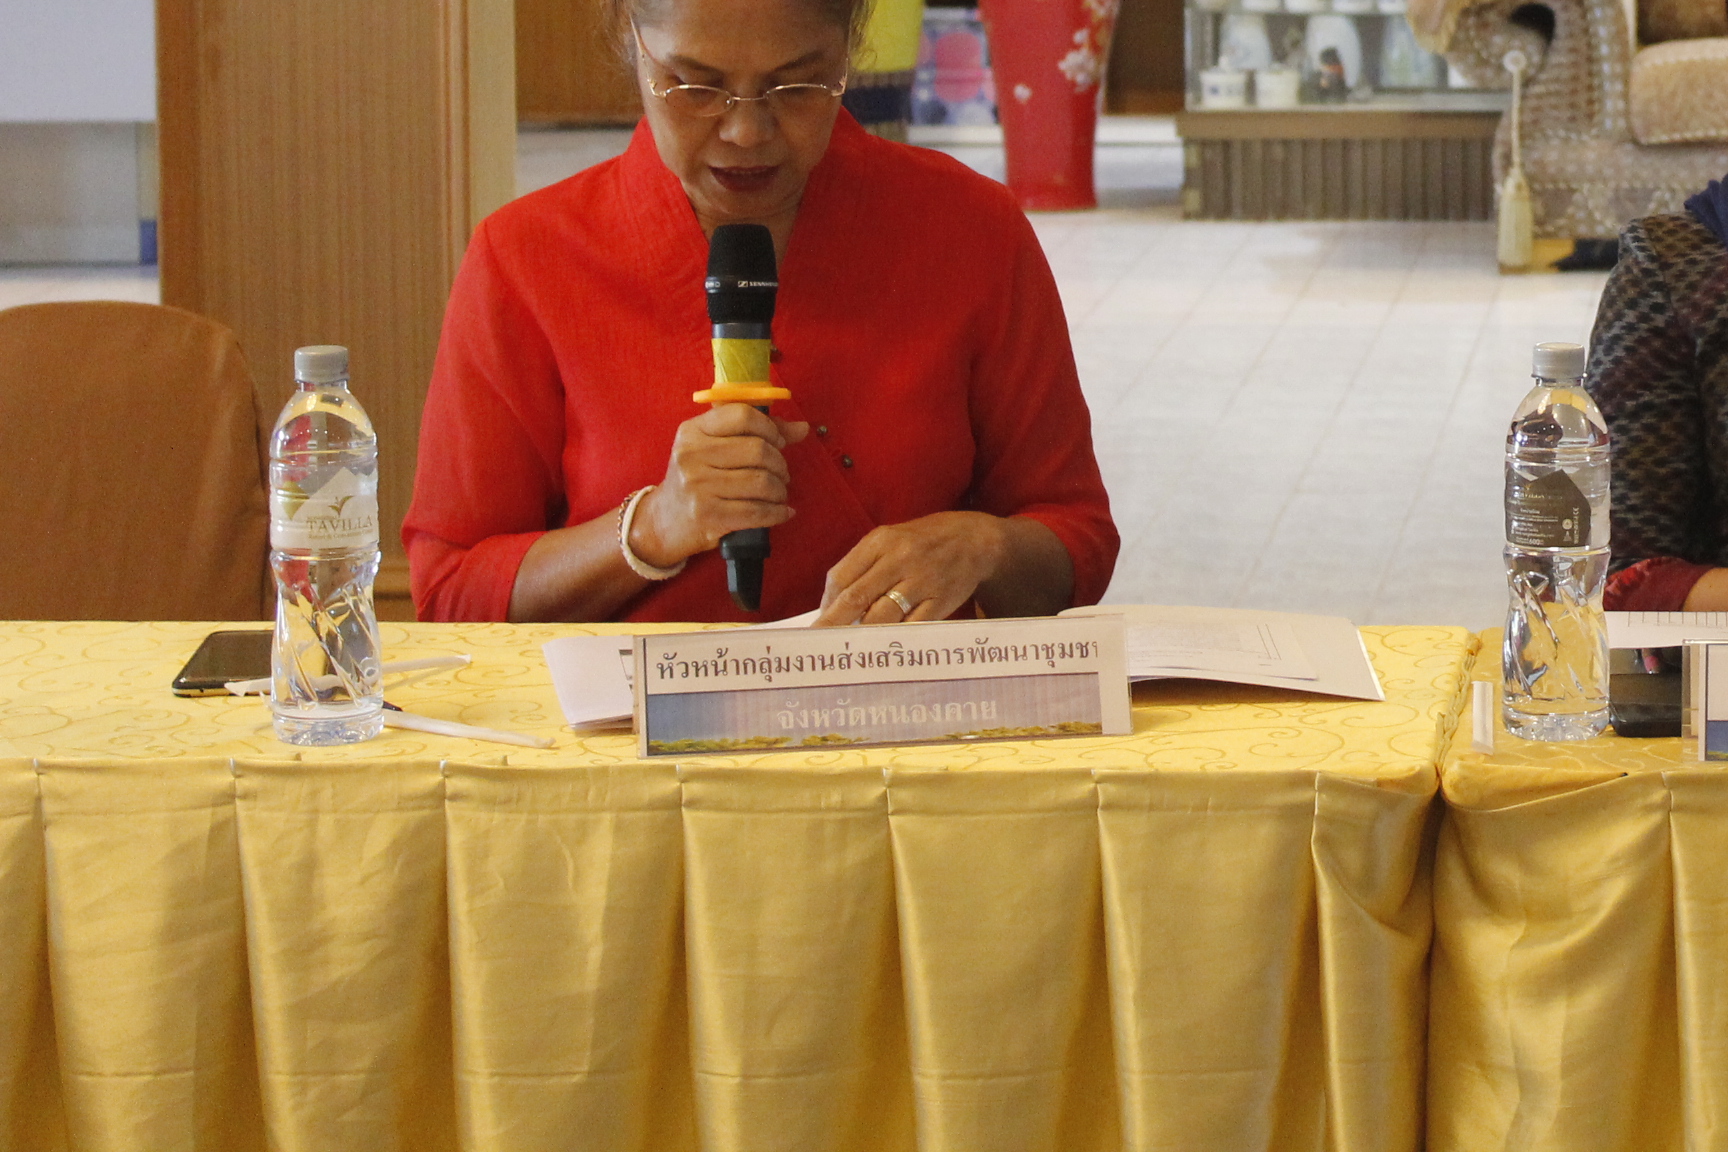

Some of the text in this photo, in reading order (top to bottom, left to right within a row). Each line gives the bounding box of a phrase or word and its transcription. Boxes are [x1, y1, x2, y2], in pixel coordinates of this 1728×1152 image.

[776, 698, 997, 730] จังหวัดหนองคาย
